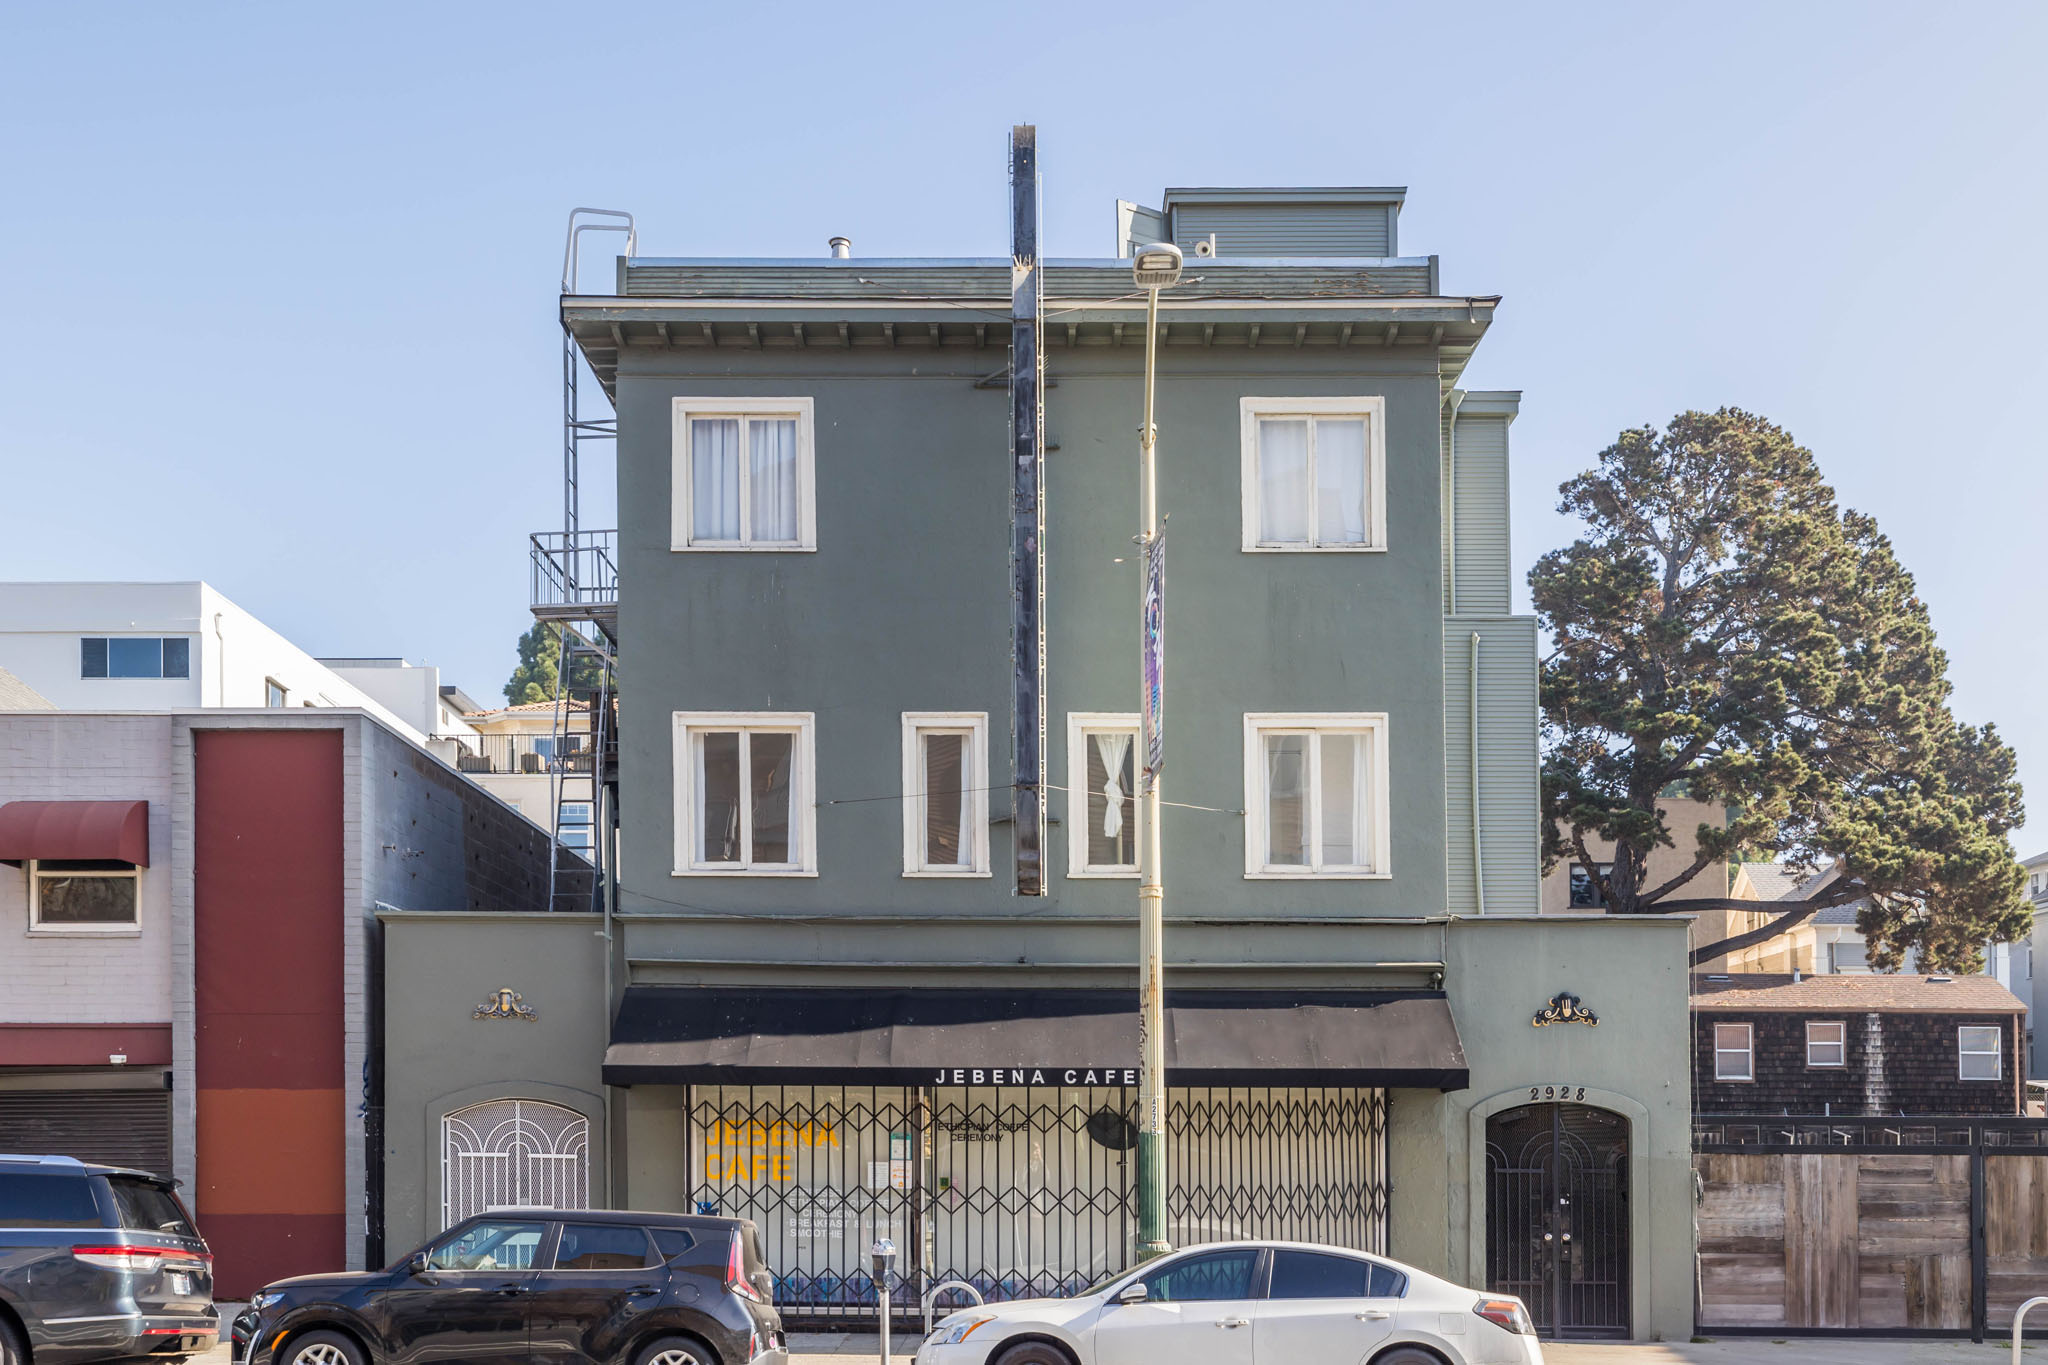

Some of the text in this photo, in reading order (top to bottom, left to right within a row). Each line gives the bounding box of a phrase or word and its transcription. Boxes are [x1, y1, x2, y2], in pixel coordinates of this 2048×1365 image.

[935, 1069, 1136, 1084] JEBENA CAFE
[1529, 1086, 1586, 1102] 2928
[706, 1119, 839, 1147] JEBENA
[951, 1133, 1004, 1142] CEREMONY
[705, 1153, 791, 1181] CAFE
[789, 1218, 848, 1228] BREAKFAST
[866, 1219, 902, 1229] LUNCH
[790, 1228, 843, 1238] SMOOTHIE
